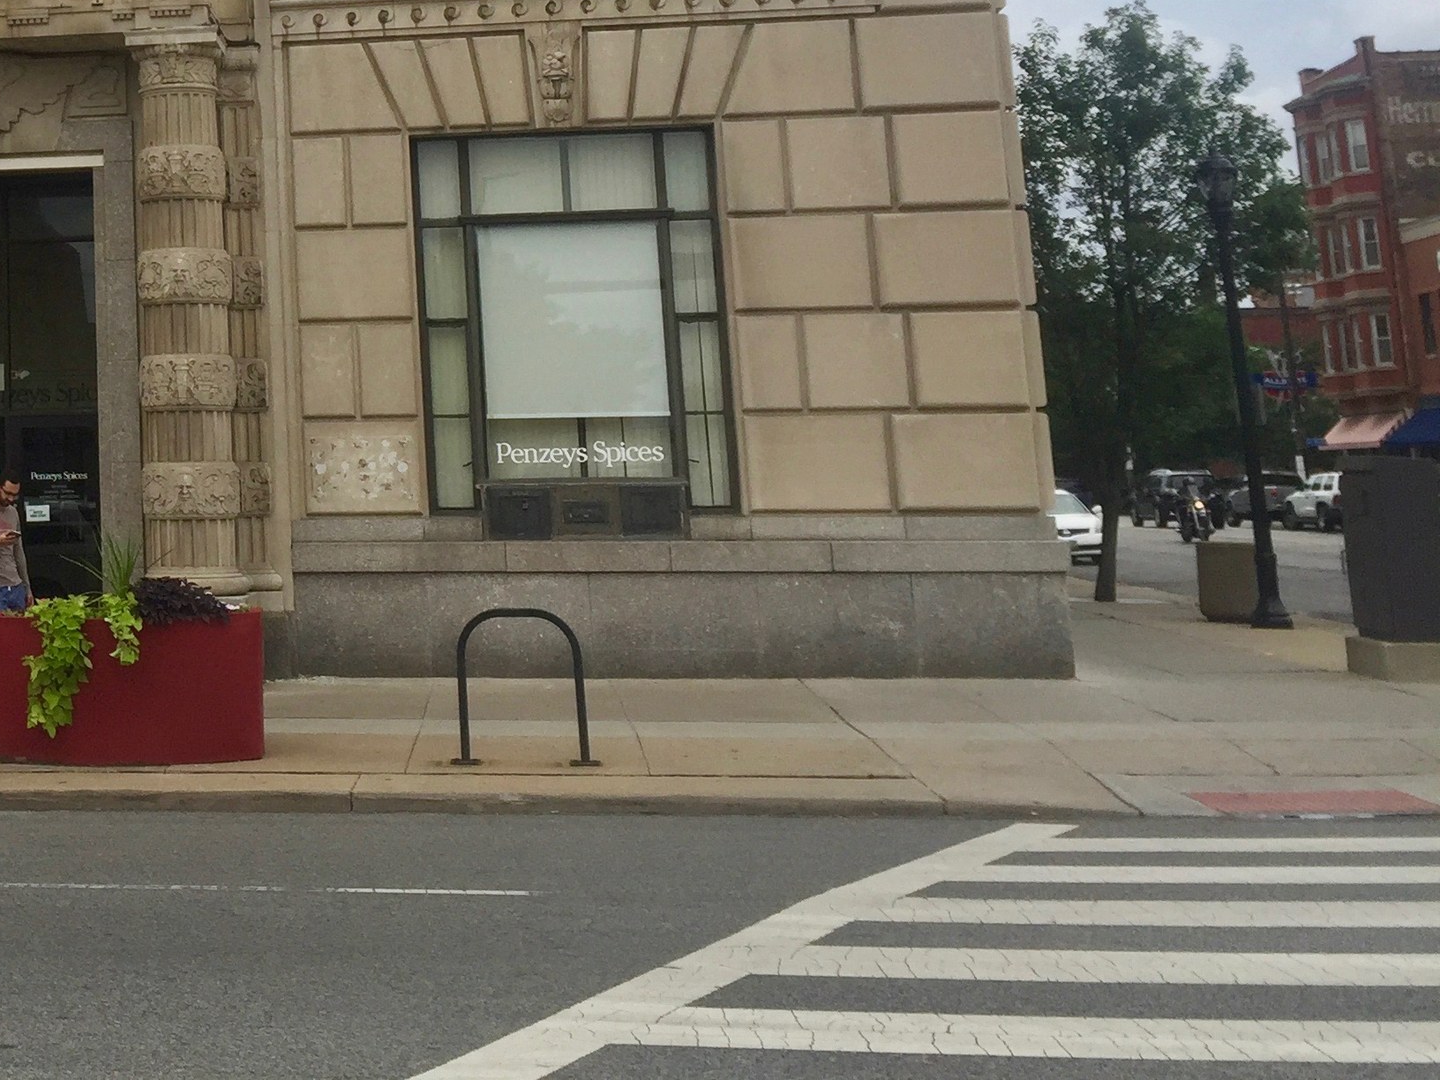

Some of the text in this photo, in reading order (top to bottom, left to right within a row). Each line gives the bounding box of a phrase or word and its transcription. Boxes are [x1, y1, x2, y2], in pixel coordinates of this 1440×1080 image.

[495, 440, 665, 468] Penzeys Spices
[30, 470, 88, 482] Penzeys Spices
